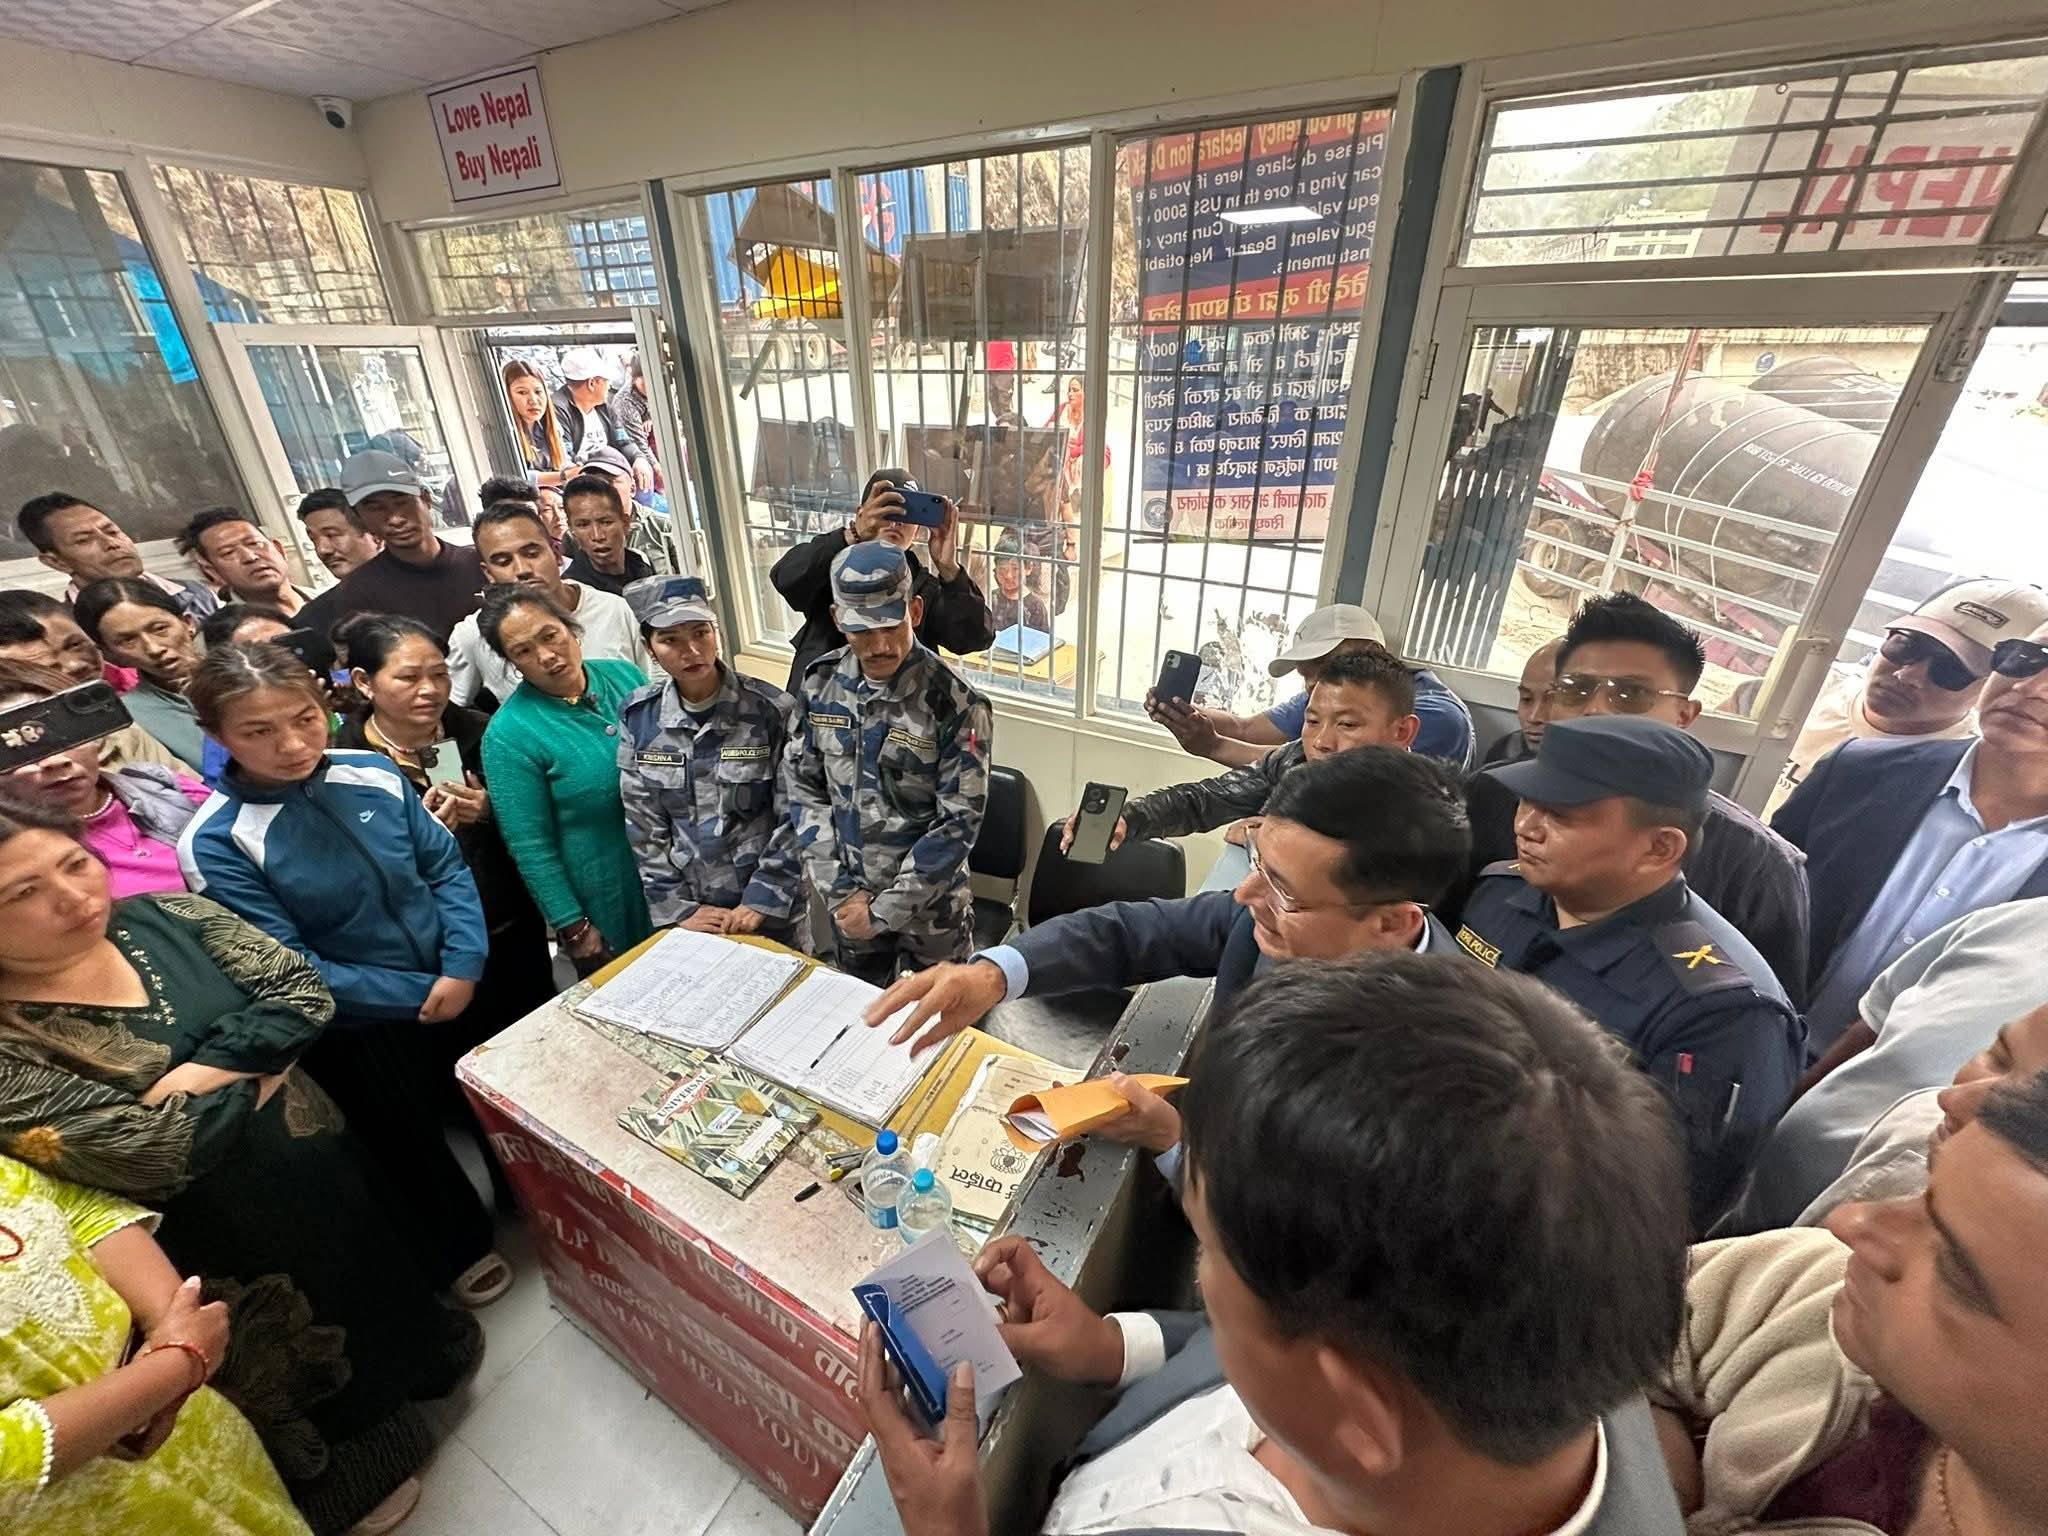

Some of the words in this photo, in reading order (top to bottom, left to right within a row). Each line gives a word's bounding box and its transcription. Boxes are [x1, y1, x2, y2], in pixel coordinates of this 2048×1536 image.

[442, 103, 481, 134] Love
[480, 82, 532, 129] Nepal
[455, 150, 487, 186] Buy
[486, 135, 541, 180] Nepali
[656, 1073, 709, 1119] UNIVERSAL
